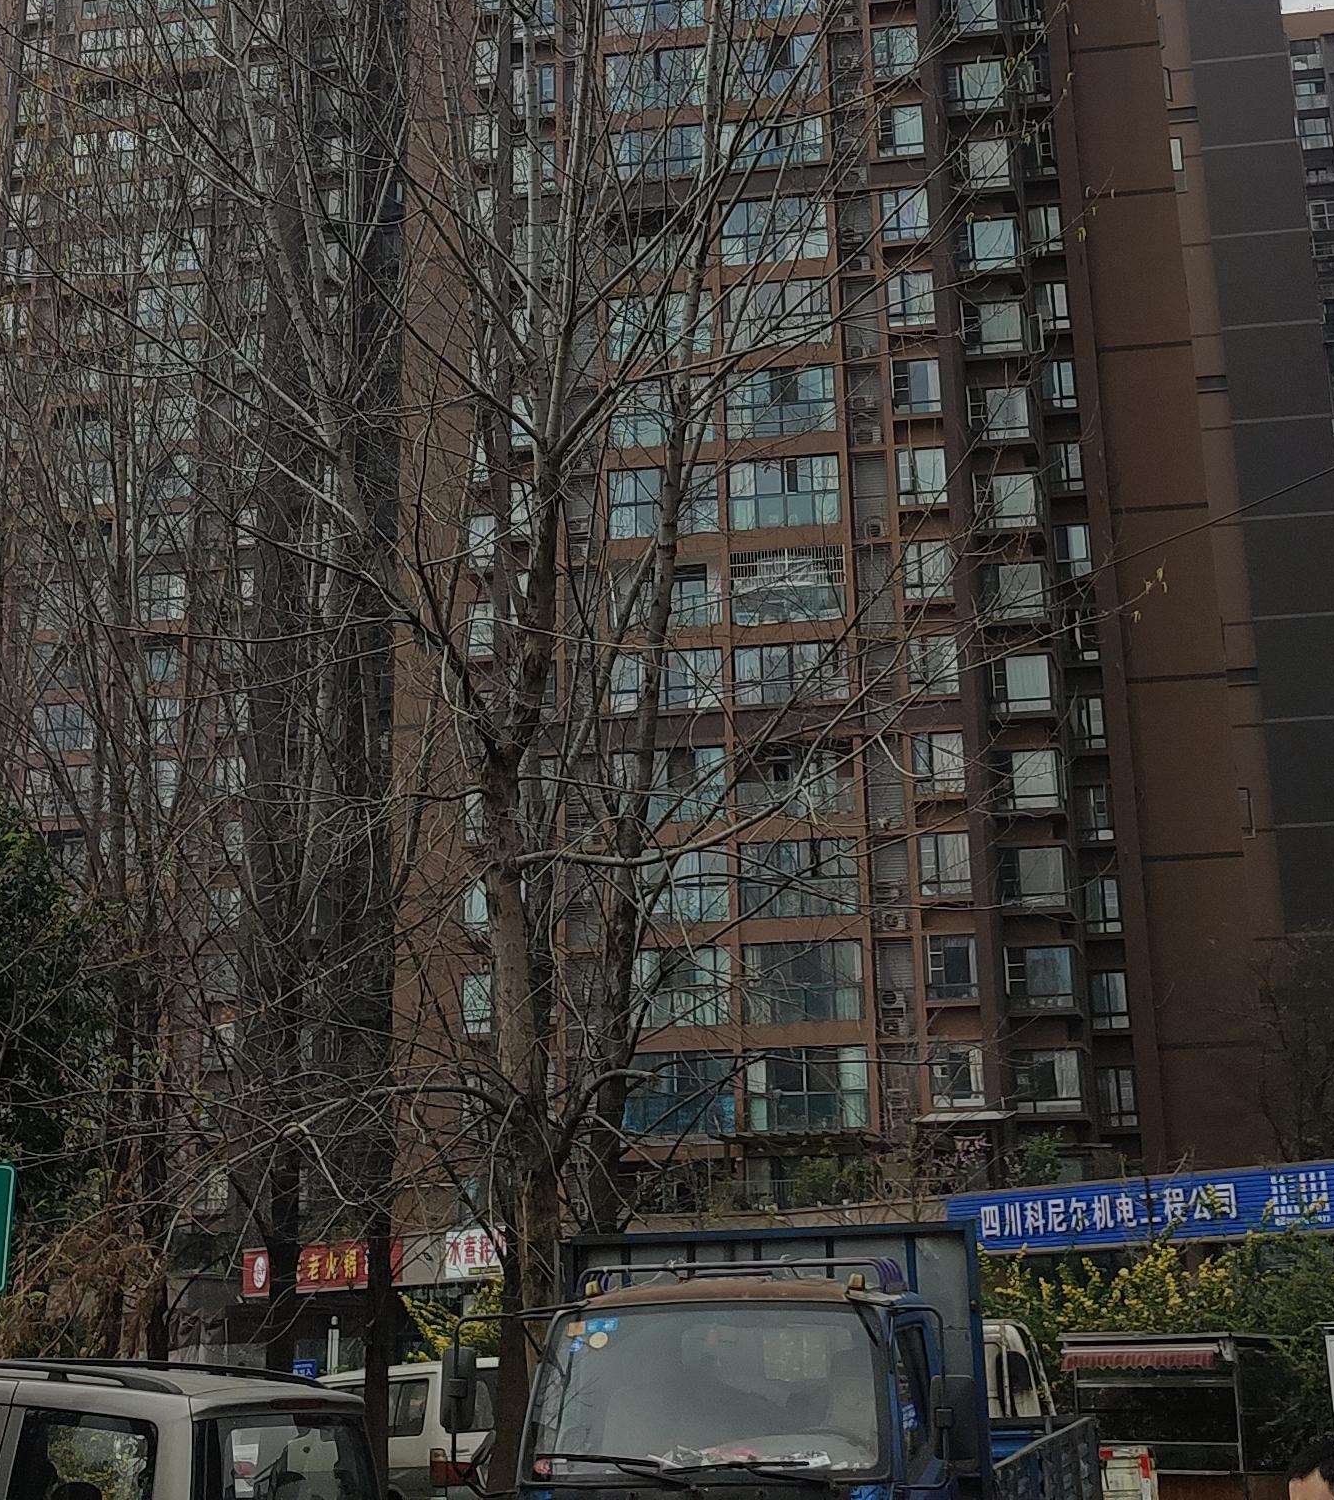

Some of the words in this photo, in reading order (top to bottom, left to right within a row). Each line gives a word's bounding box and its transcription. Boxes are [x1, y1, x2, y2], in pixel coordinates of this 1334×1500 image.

[980, 1183, 1238, 1238] 四川科尼尔机电工程公司
[298, 1249, 358, 1285] 老火锅
